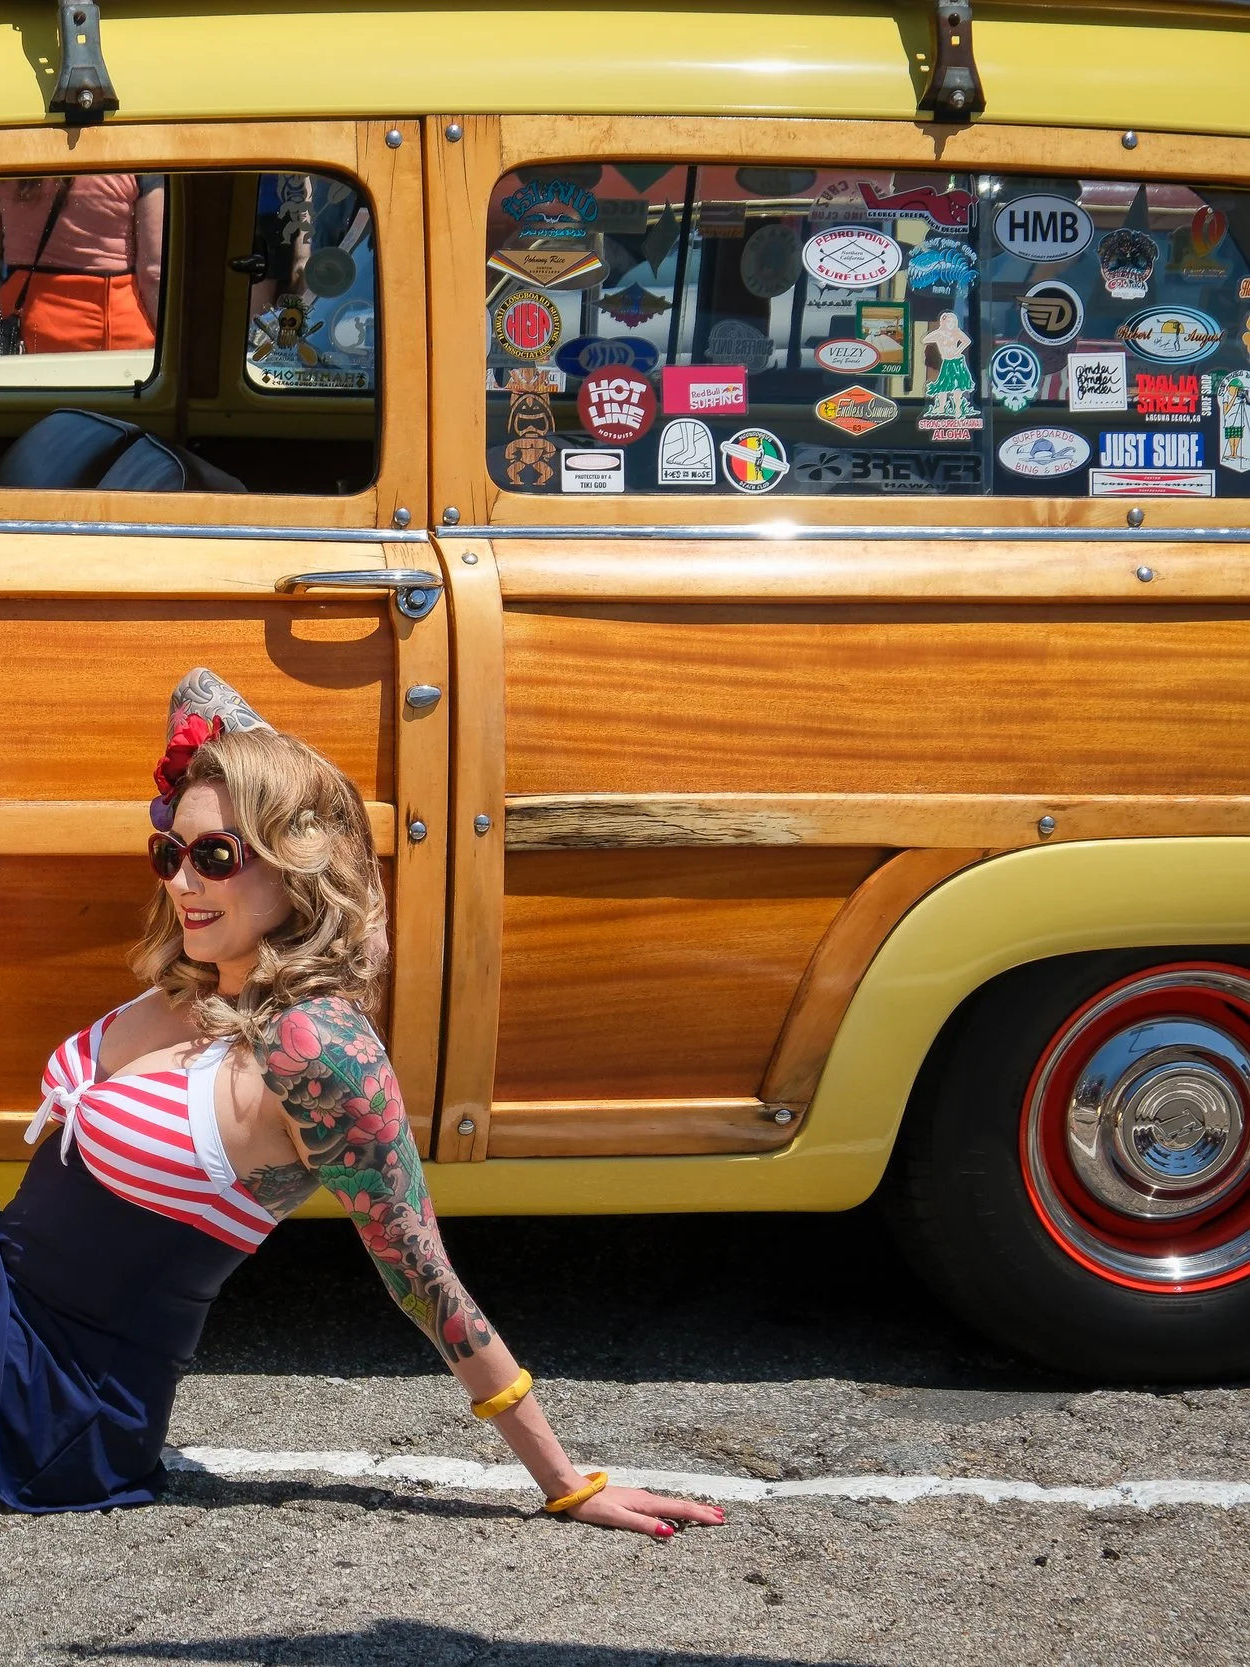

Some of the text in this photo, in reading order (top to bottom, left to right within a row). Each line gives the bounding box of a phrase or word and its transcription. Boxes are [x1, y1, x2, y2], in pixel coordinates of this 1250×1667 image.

[1009, 210, 1079, 243] HMB
[815, 231, 891, 249] PEDRO POINT
[524, 255, 566, 264] Johnny Rice
[817, 264, 888, 281] SURF CLUB
[505, 292, 550, 307] LONGBOARD
[550, 307, 560, 342] SURFING
[1117, 324, 1153, 340] Robert
[1184, 329, 1225, 347] August
[503, 342, 552, 358] ASSOCIATION
[829, 347, 867, 357] VELZY
[881, 365, 902, 373] 2000
[588, 379, 647, 403] HOT
[692, 388, 721, 398] Red Bull
[1136, 374, 1199, 395] THALIA
[690, 394, 744, 410] SURFING
[1138, 394, 1199, 413] STREET
[1201, 374, 1212, 417] SURF SHOP
[836, 397, 898, 418] Endless Summer
[588, 403, 645, 430] LINE
[598, 429, 634, 439] HOTSUITS
[932, 429, 971, 440] ALOHA
[1013, 430, 1075, 445] SURFBOARDS
[1100, 434, 1203, 467] JUST SURF.
[691, 470, 710, 478] NOSE
[852, 452, 982, 481] BREWER
[1015, 462, 1039, 474] BING
[1054, 459, 1078, 472] RICK
